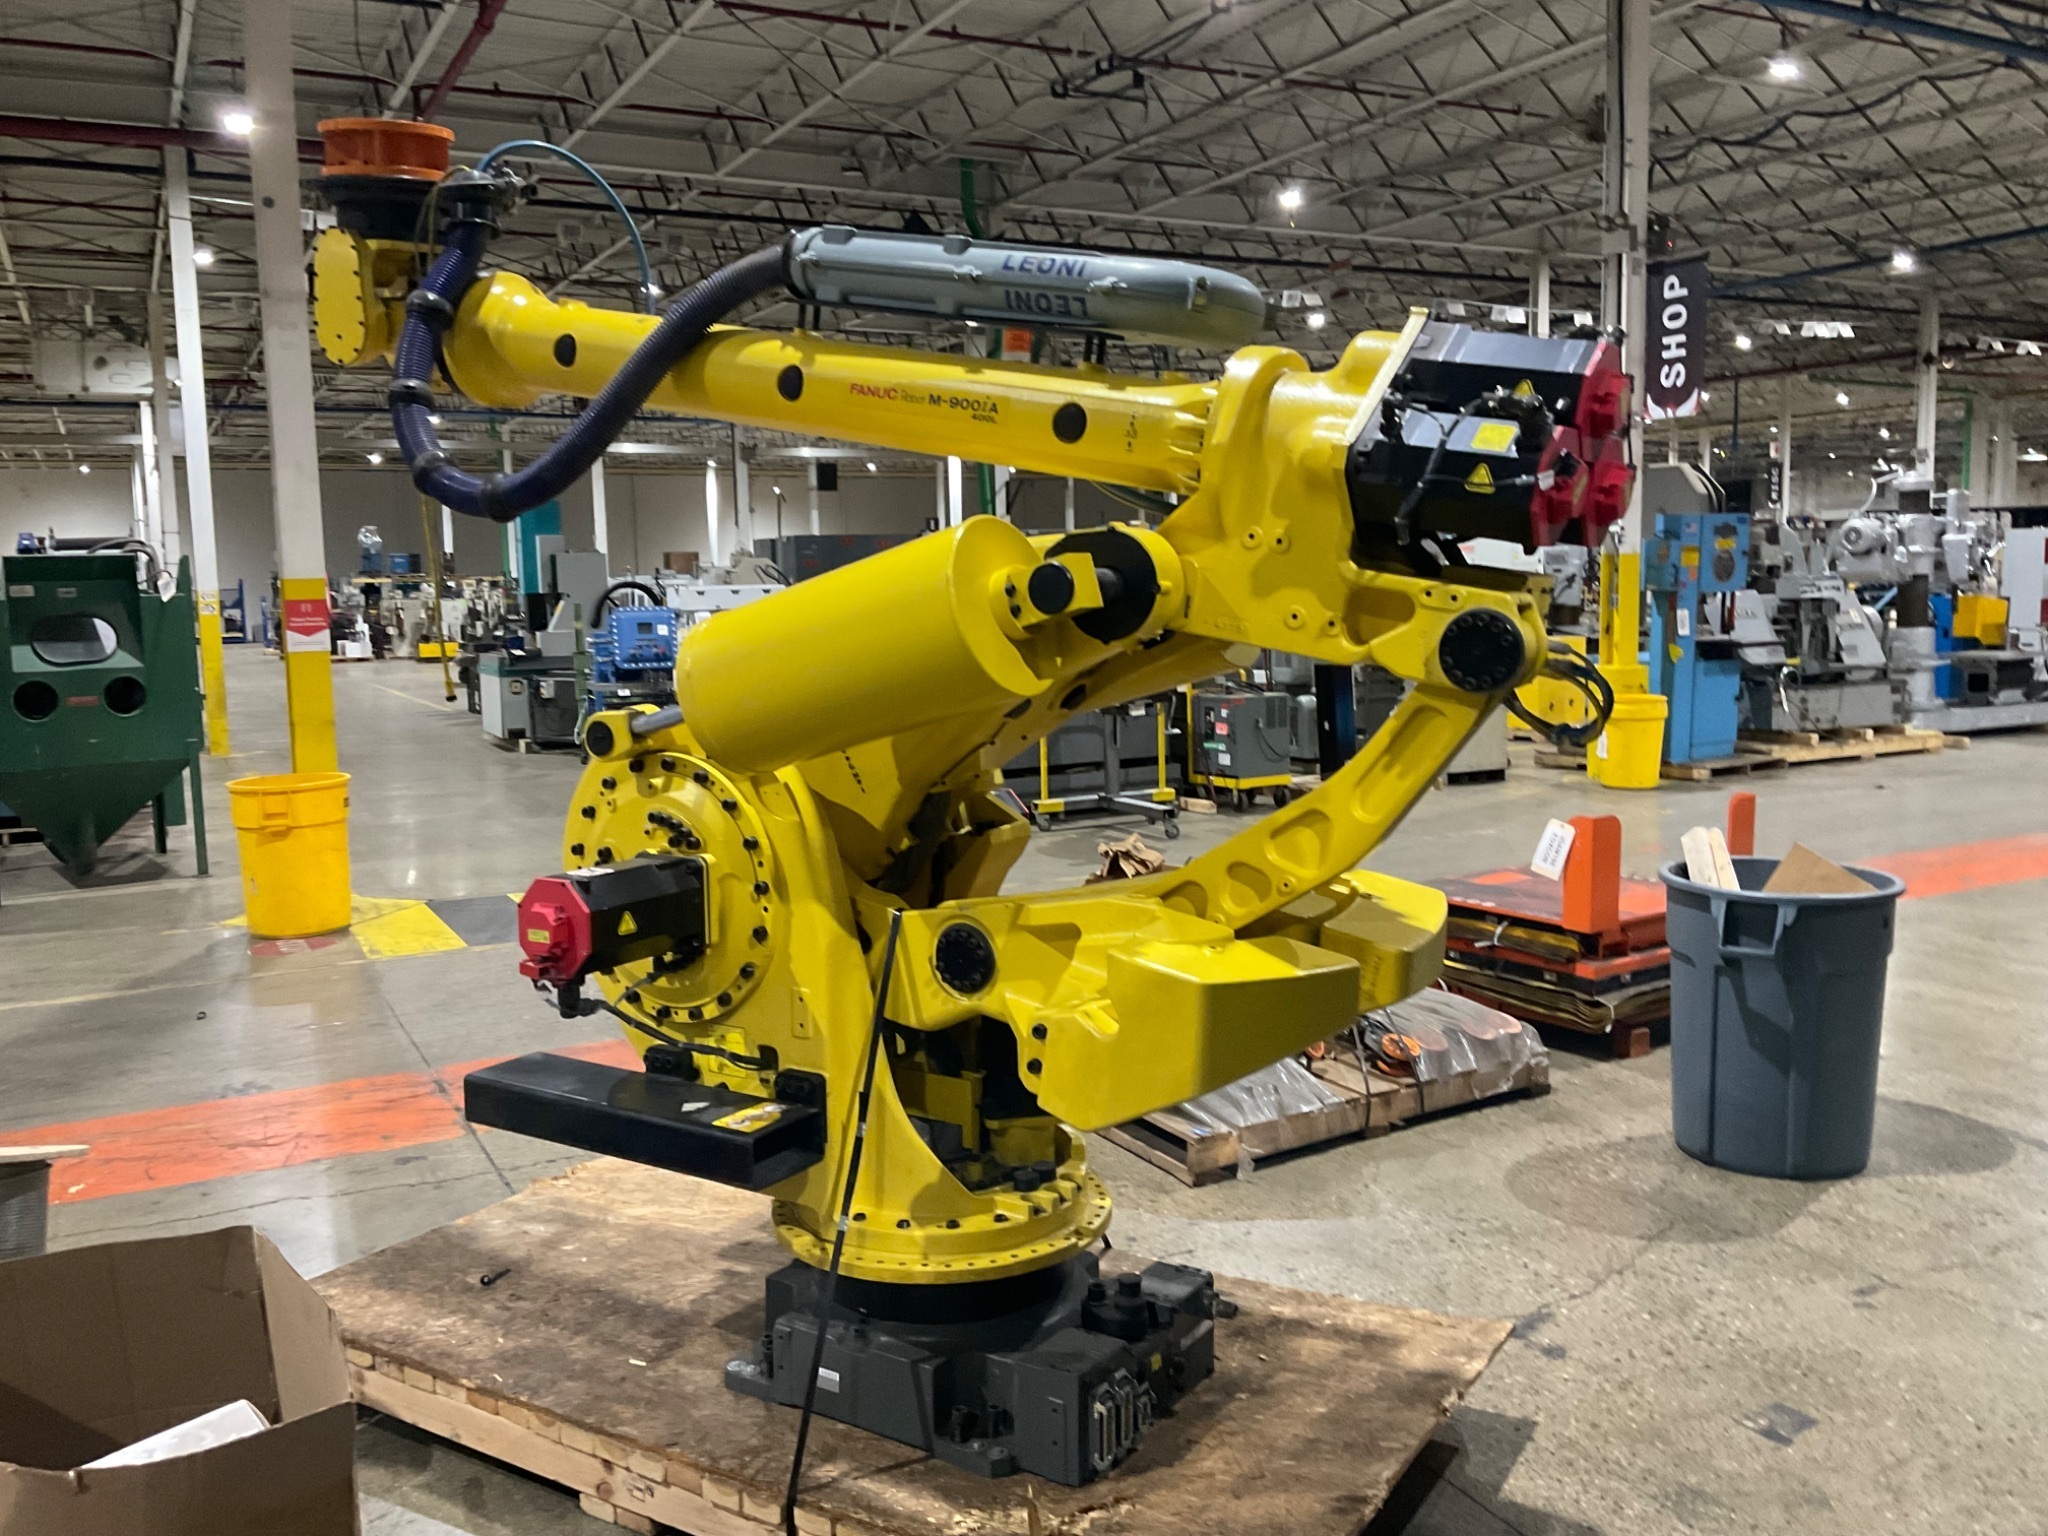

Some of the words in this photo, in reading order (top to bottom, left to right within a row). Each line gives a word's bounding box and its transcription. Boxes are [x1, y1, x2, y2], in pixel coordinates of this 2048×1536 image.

[1002, 254, 1087, 277] LEONI
[1005, 289, 1089, 317] LEONI
[1660, 274, 1689, 388] SHOP
[850, 383, 899, 400] FANUC
